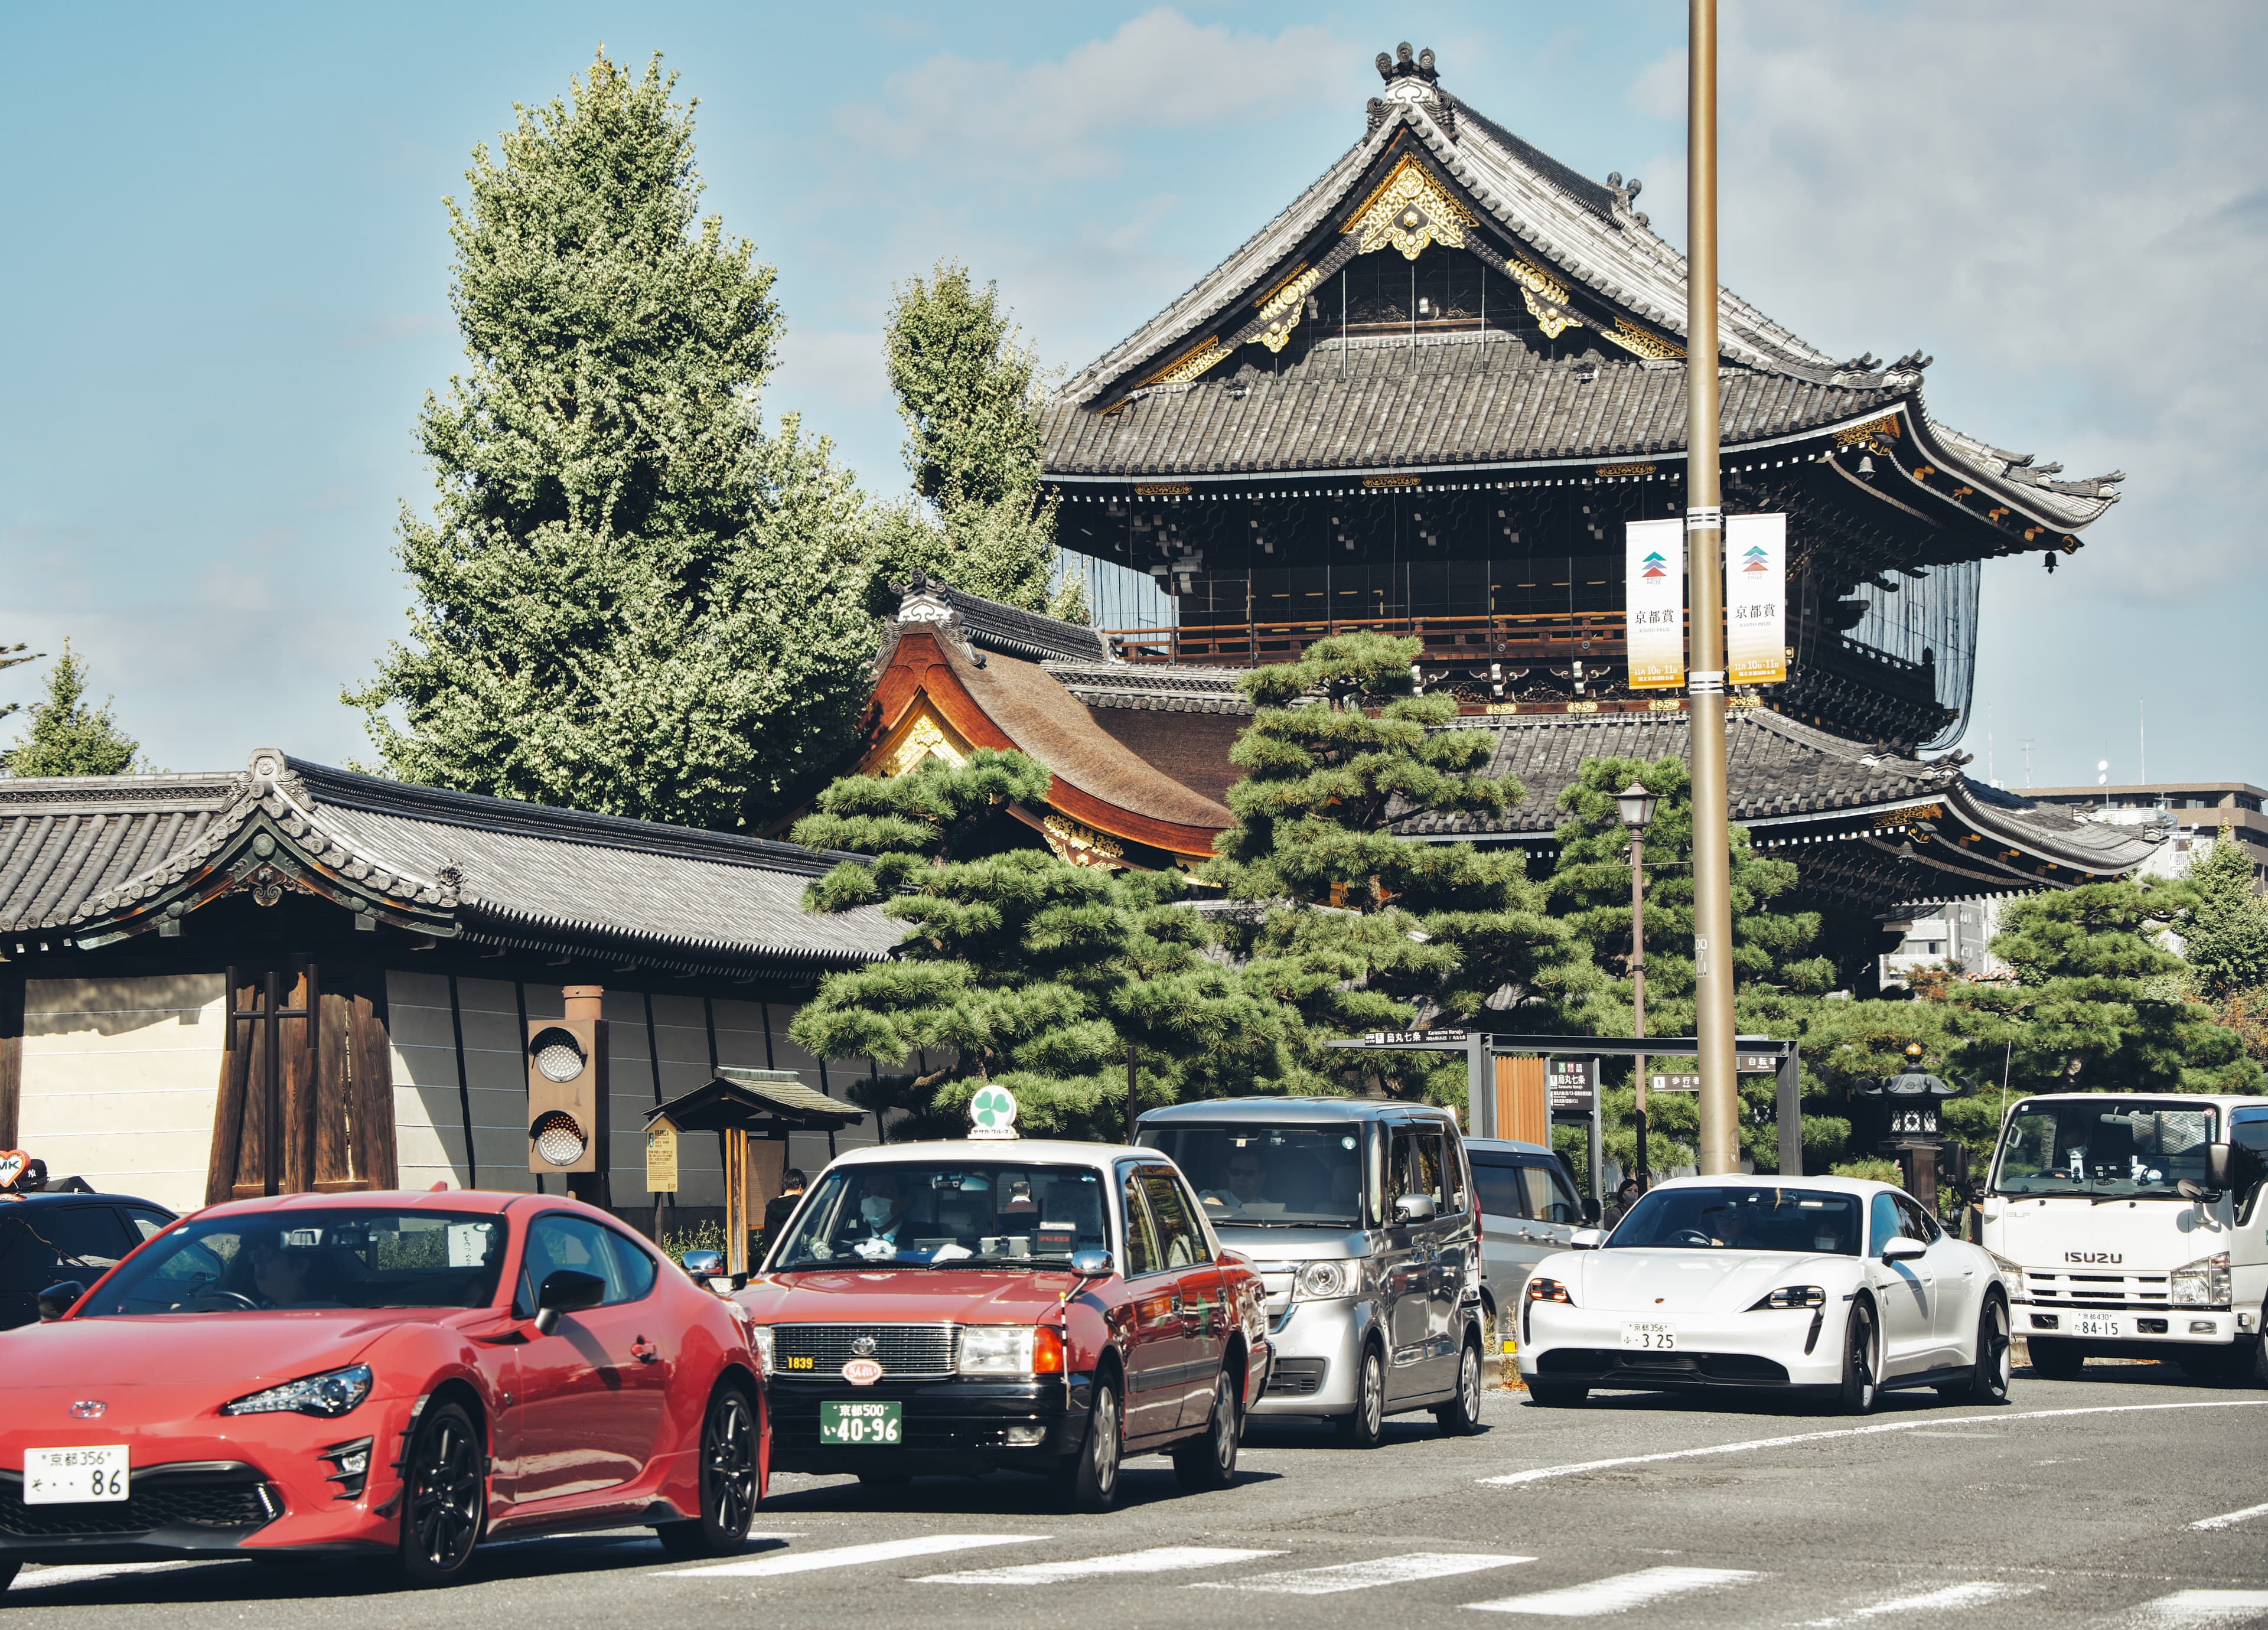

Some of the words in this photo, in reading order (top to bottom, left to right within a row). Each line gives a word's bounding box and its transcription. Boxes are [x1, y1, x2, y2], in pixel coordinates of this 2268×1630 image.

[1634, 609, 1674, 624] 京都賞
[1735, 603, 1775, 619] 京都賞
[1387, 1032, 1421, 1043] 烏丸七条
[1749, 1057, 1776, 1065] 自転車
[1558, 1074, 1585, 1084] 烏丸七条
[1671, 1077, 1699, 1085] 歩行者
[2065, 1251, 2122, 1264] ISUZU
[2083, 1322, 2119, 1335] 84-15
[787, 1357, 813, 1369] 1839
[839, 1404, 884, 1417] 京都500
[823, 1425, 836, 1436] い
[837, 1418, 898, 1441] 40-96
[50, 1451, 105, 1466] 京都356
